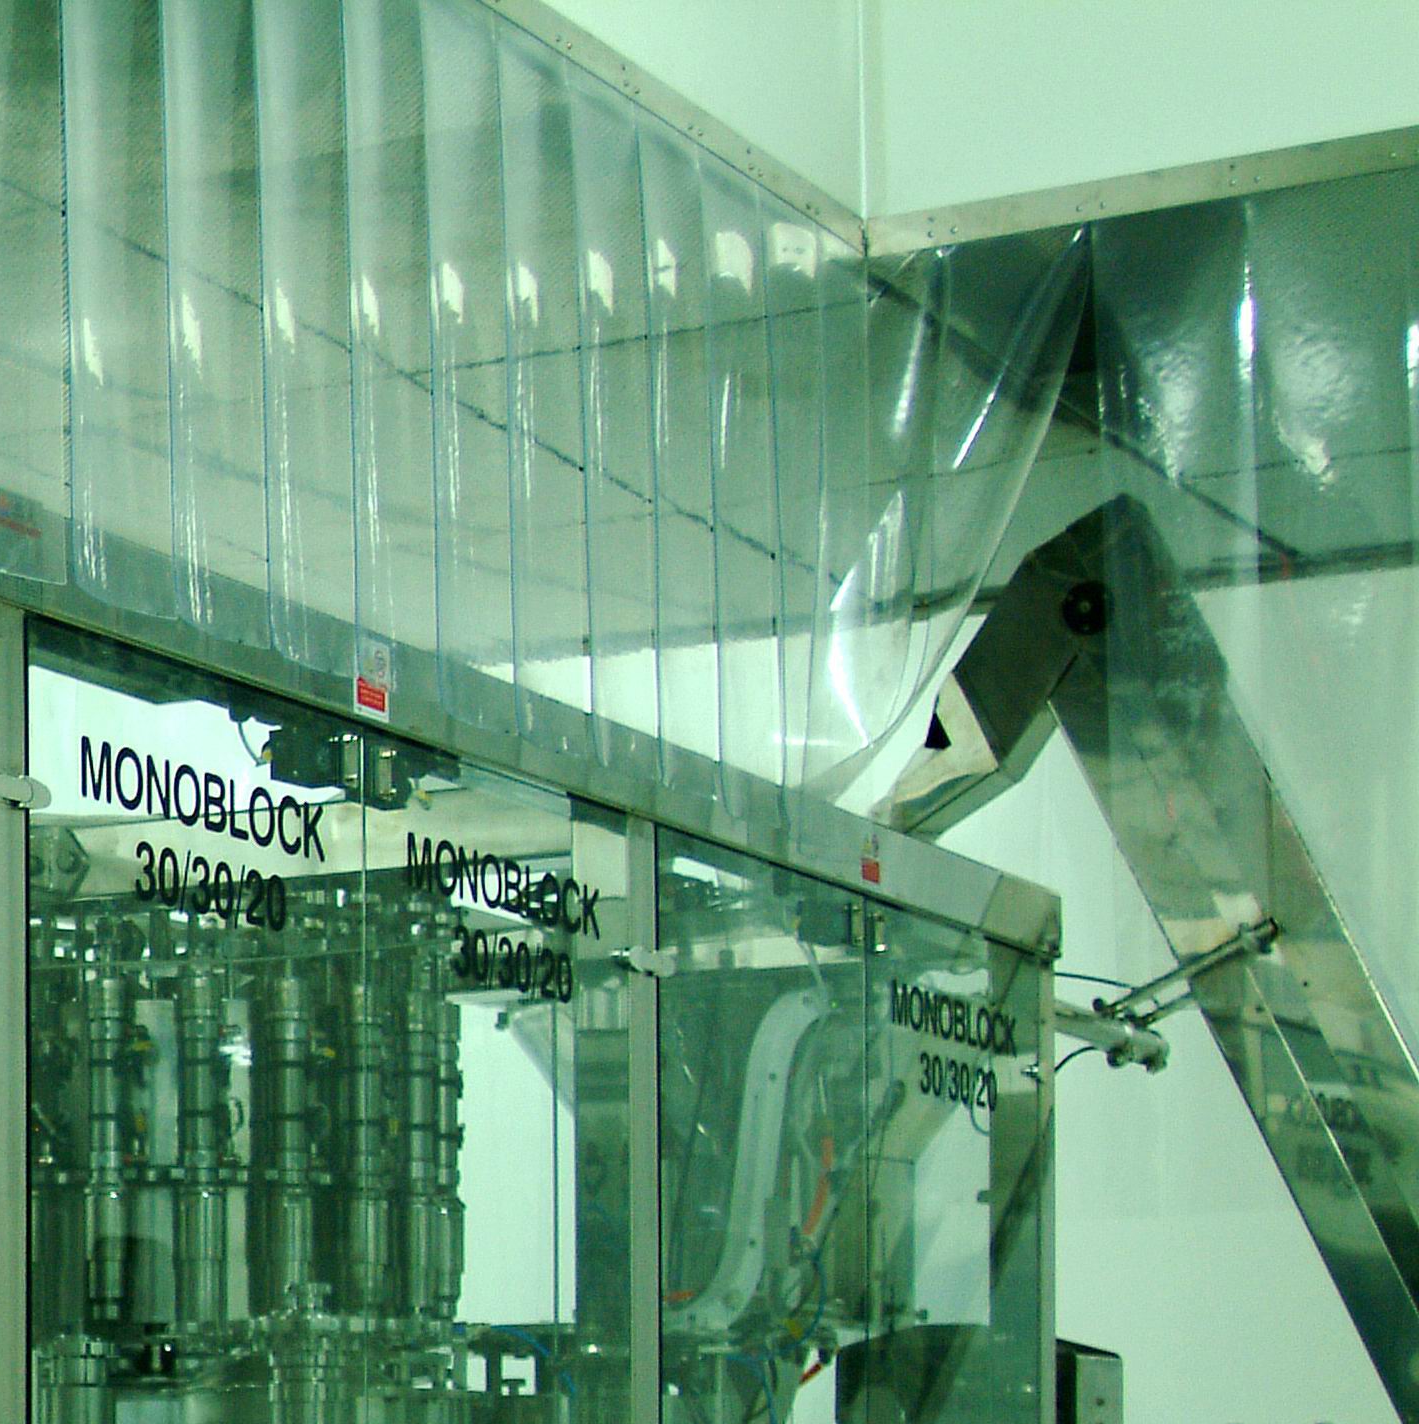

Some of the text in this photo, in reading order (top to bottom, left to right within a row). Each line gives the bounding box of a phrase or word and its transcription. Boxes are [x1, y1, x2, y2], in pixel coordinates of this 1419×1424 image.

[80, 735, 326, 862] MONOBLOCK
[135, 841, 287, 932] 30/30/20
[407, 831, 601, 940] MONOBLOCK
[450, 924, 573, 1003] 30/30/20
[891, 978, 1018, 1058] MONOBLOCK
